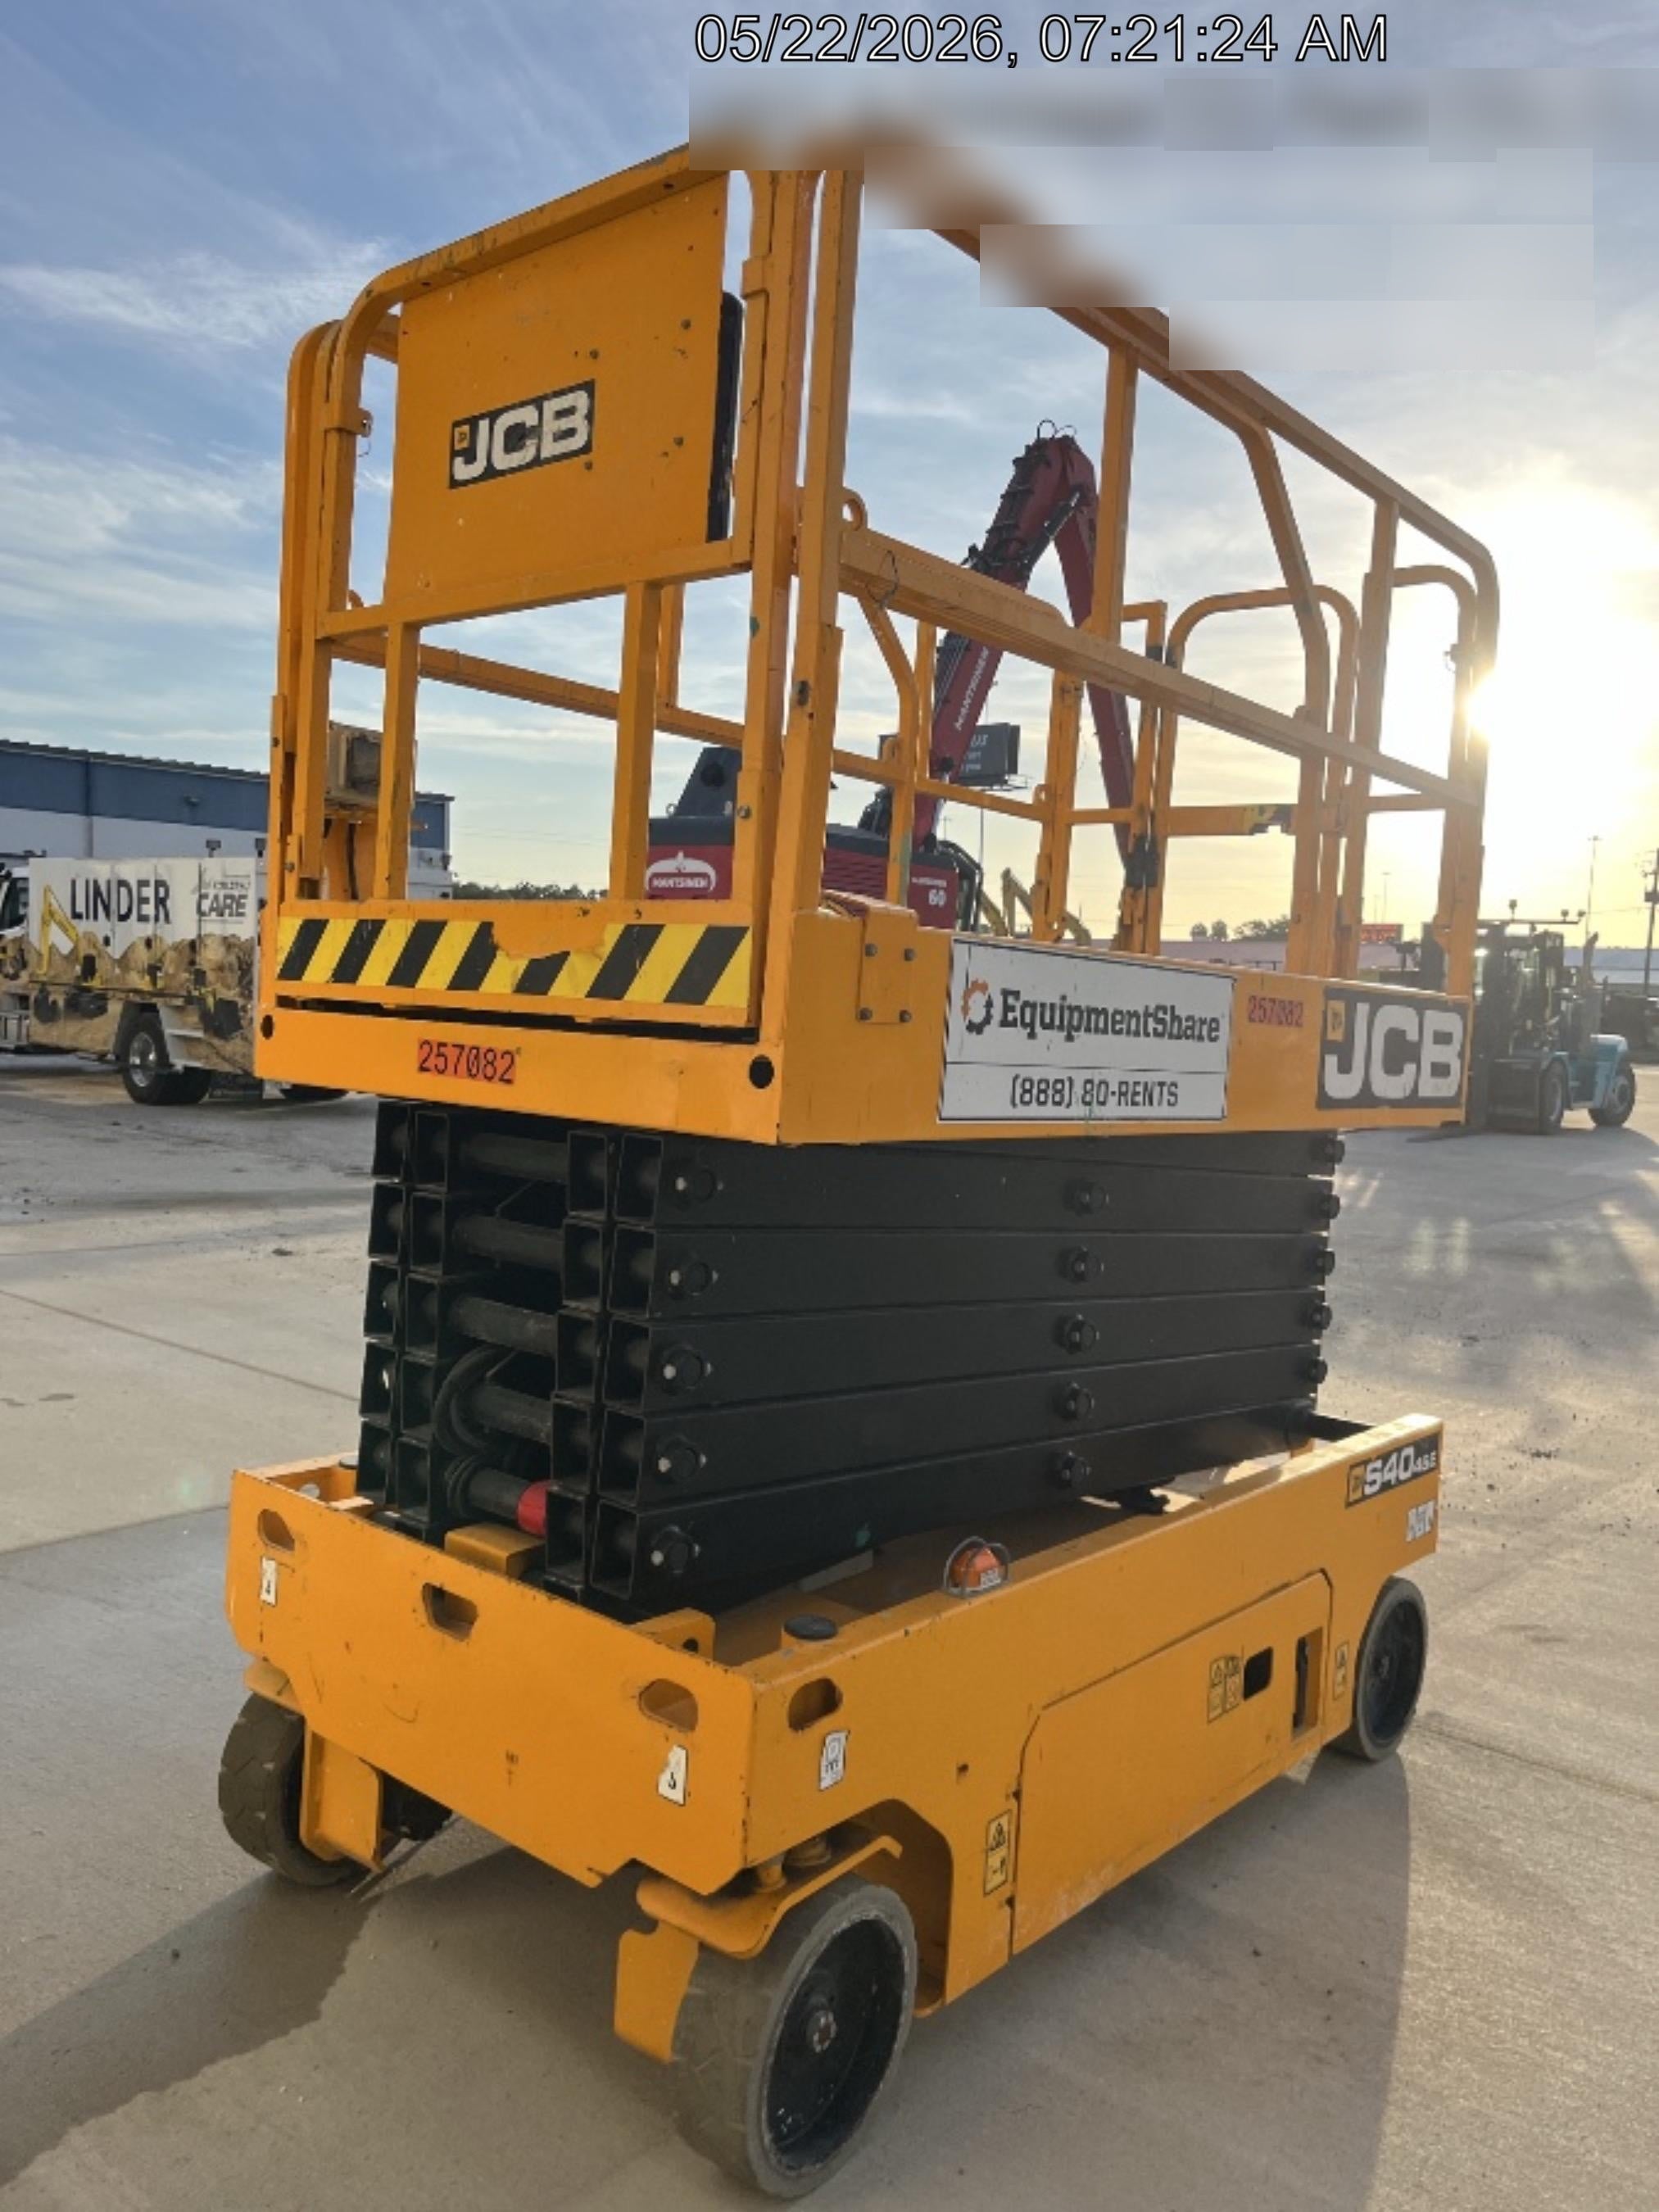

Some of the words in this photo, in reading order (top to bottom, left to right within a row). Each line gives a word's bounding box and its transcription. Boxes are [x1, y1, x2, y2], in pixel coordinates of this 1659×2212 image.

[451, 389, 591, 482] JCB
[70, 878, 171, 924] LINDER
[196, 894, 248, 918] CARE
[999, 987, 1221, 1043] EquipmentShare
[418, 1039, 516, 1085] 257082
[1323, 1001, 1464, 1099] JCB
[1010, 1074, 1074, 1108] (888)
[1081, 1078, 1180, 1107] 80-RENTS
